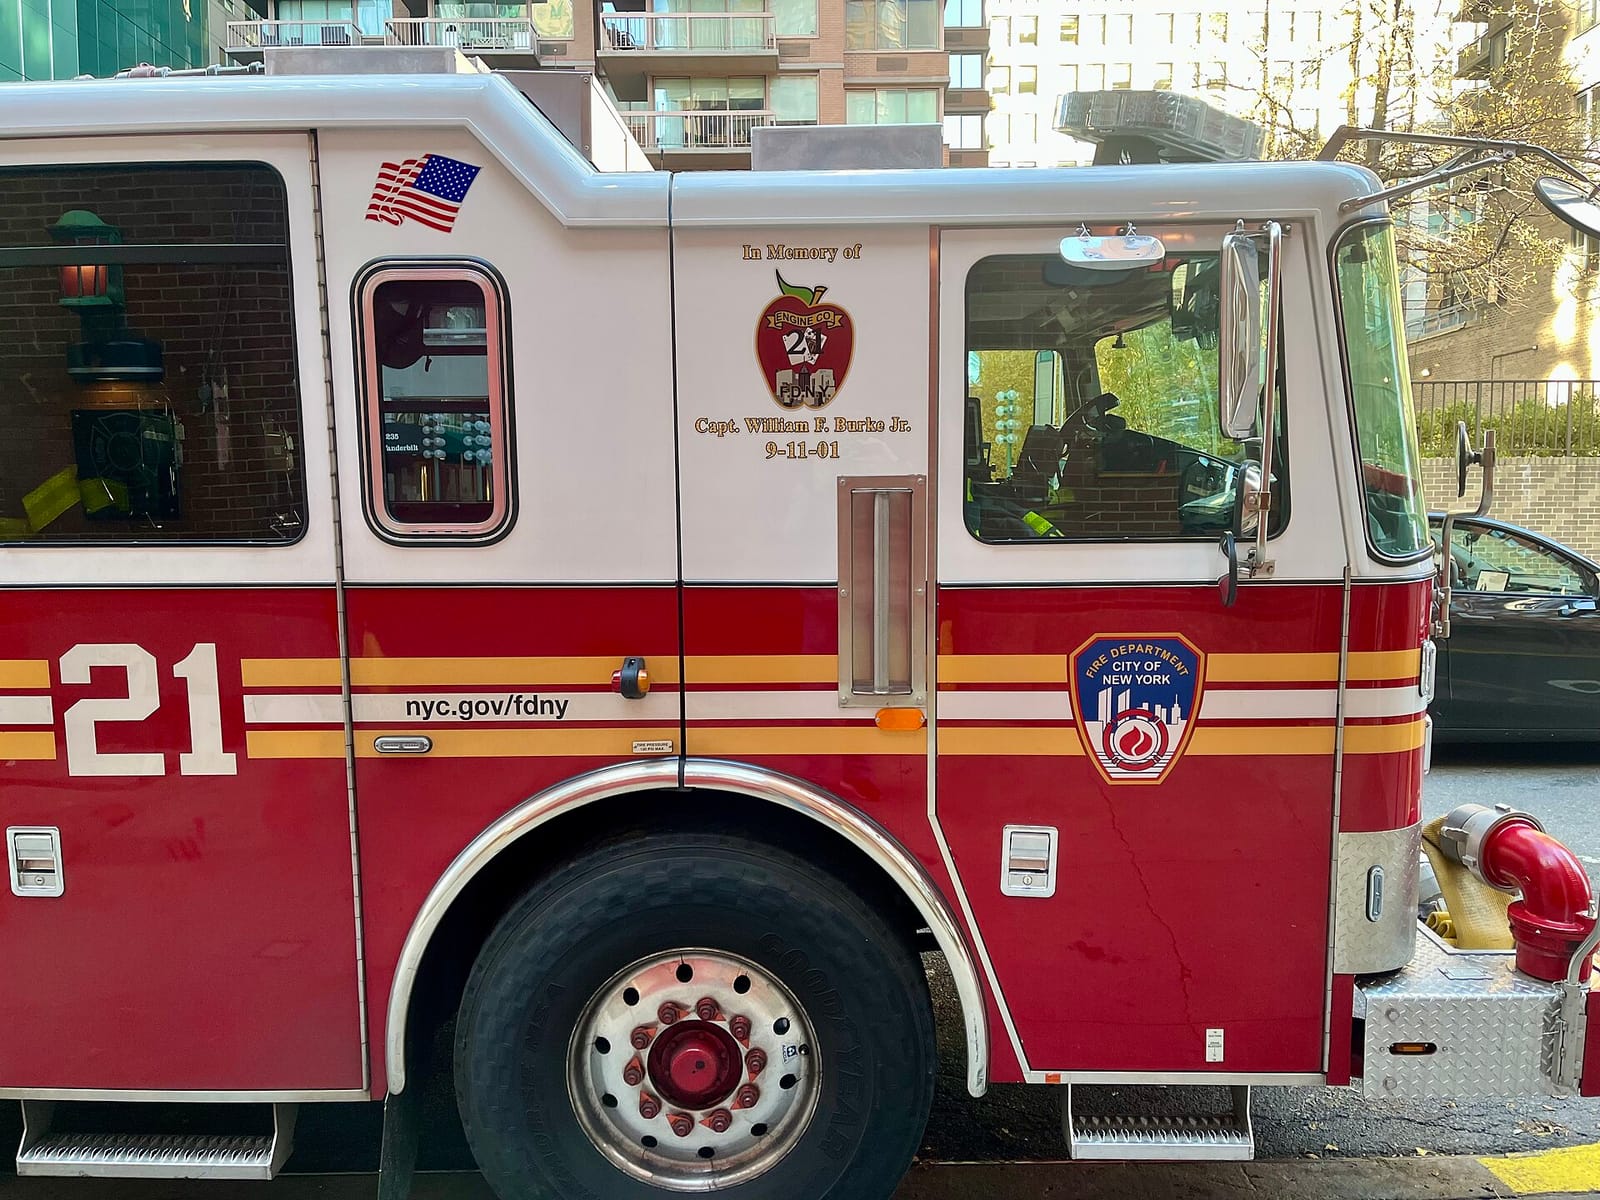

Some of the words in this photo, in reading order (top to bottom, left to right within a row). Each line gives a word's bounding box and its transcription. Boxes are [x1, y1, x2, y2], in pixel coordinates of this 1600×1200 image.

[742, 244, 762, 260] In
[766, 244, 839, 263] Memory
[843, 243, 862, 260] of
[776, 312, 814, 326] ENGINE
[785, 328, 824, 355] 21
[694, 417, 741, 437] Capt.
[744, 417, 810, 433] William
[814, 416, 830, 433] F.
[834, 416, 885, 432] Burke
[889, 416, 912, 432] Jr.
[385, 433, 400, 441] 235
[765, 441, 840, 459] 9-11-01
[1085, 653, 1109, 679] FIRE
[1110, 643, 1190, 677] DEPARTMENT
[1112, 661, 1141, 672] CITY
[1144, 661, 1162, 672] OF
[1102, 674, 1133, 685] NEW
[1136, 674, 1171, 685] YORK
[59, 642, 238, 777] 21
[406, 694, 569, 720] nyc.gov/fdny
